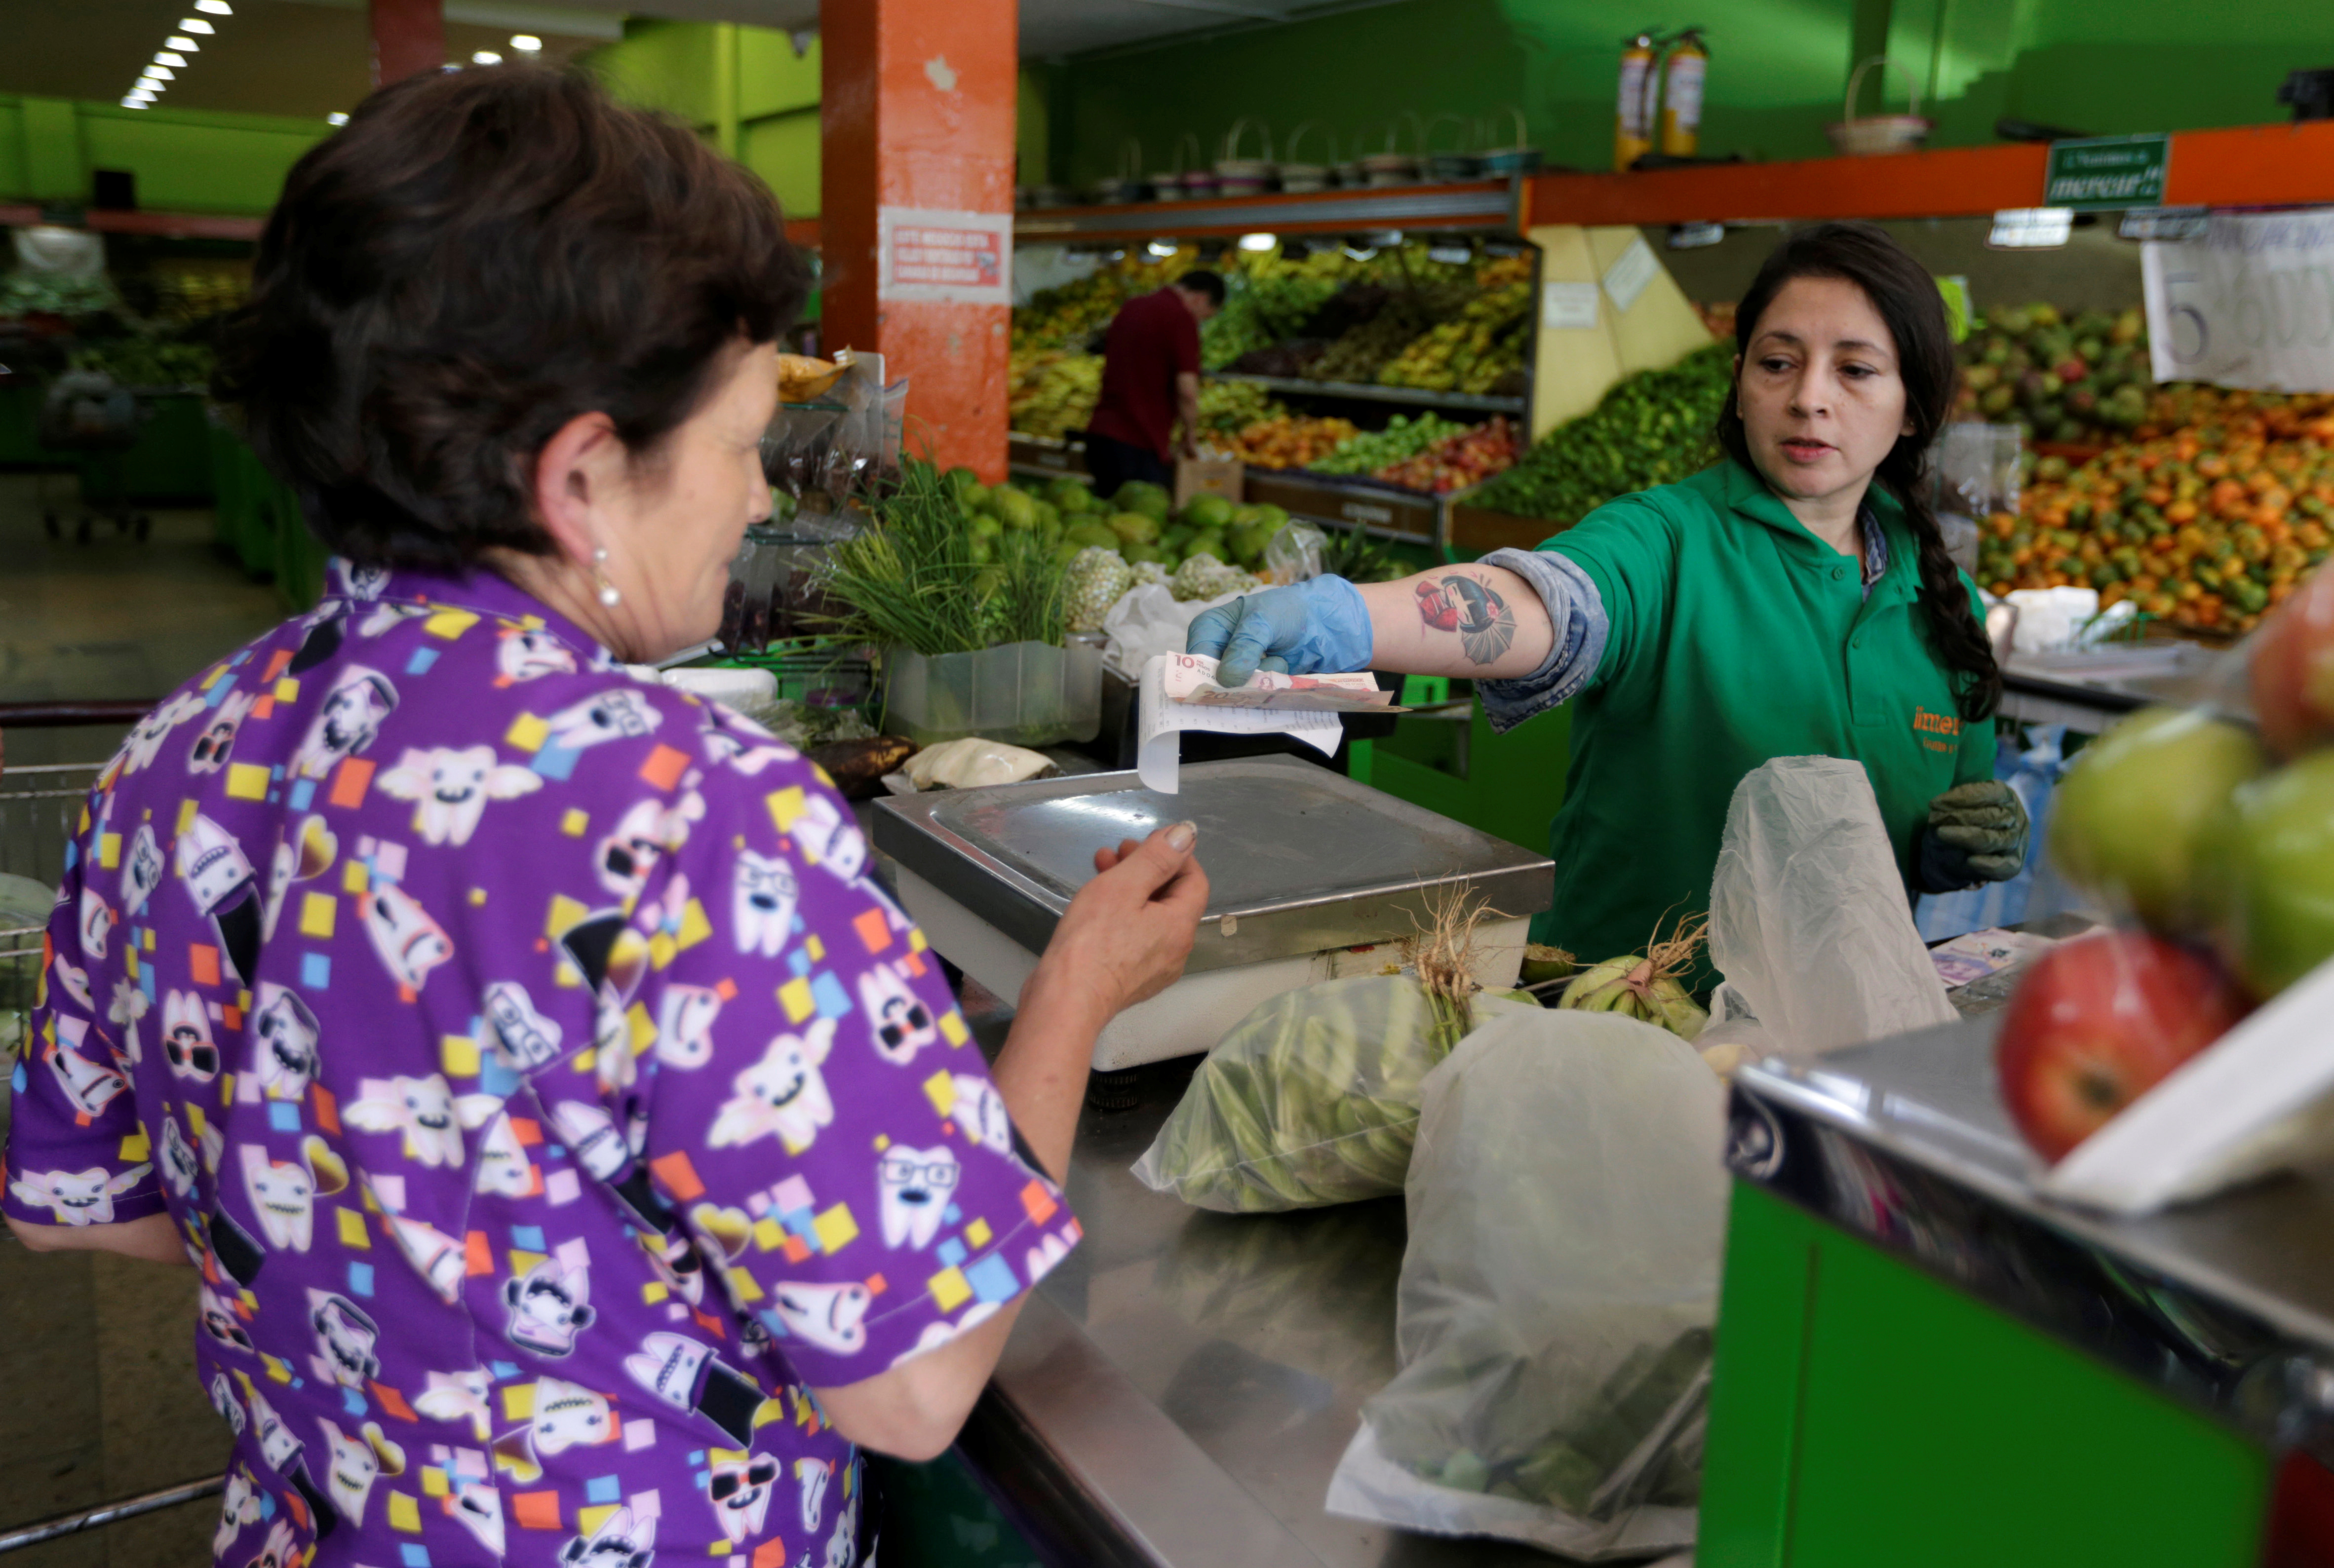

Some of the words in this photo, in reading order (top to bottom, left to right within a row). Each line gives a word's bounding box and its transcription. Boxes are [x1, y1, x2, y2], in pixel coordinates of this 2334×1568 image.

[1175, 654, 1194, 669] 10
[1197, 663, 1210, 672] PESOS
[1204, 690, 1229, 699] 20
